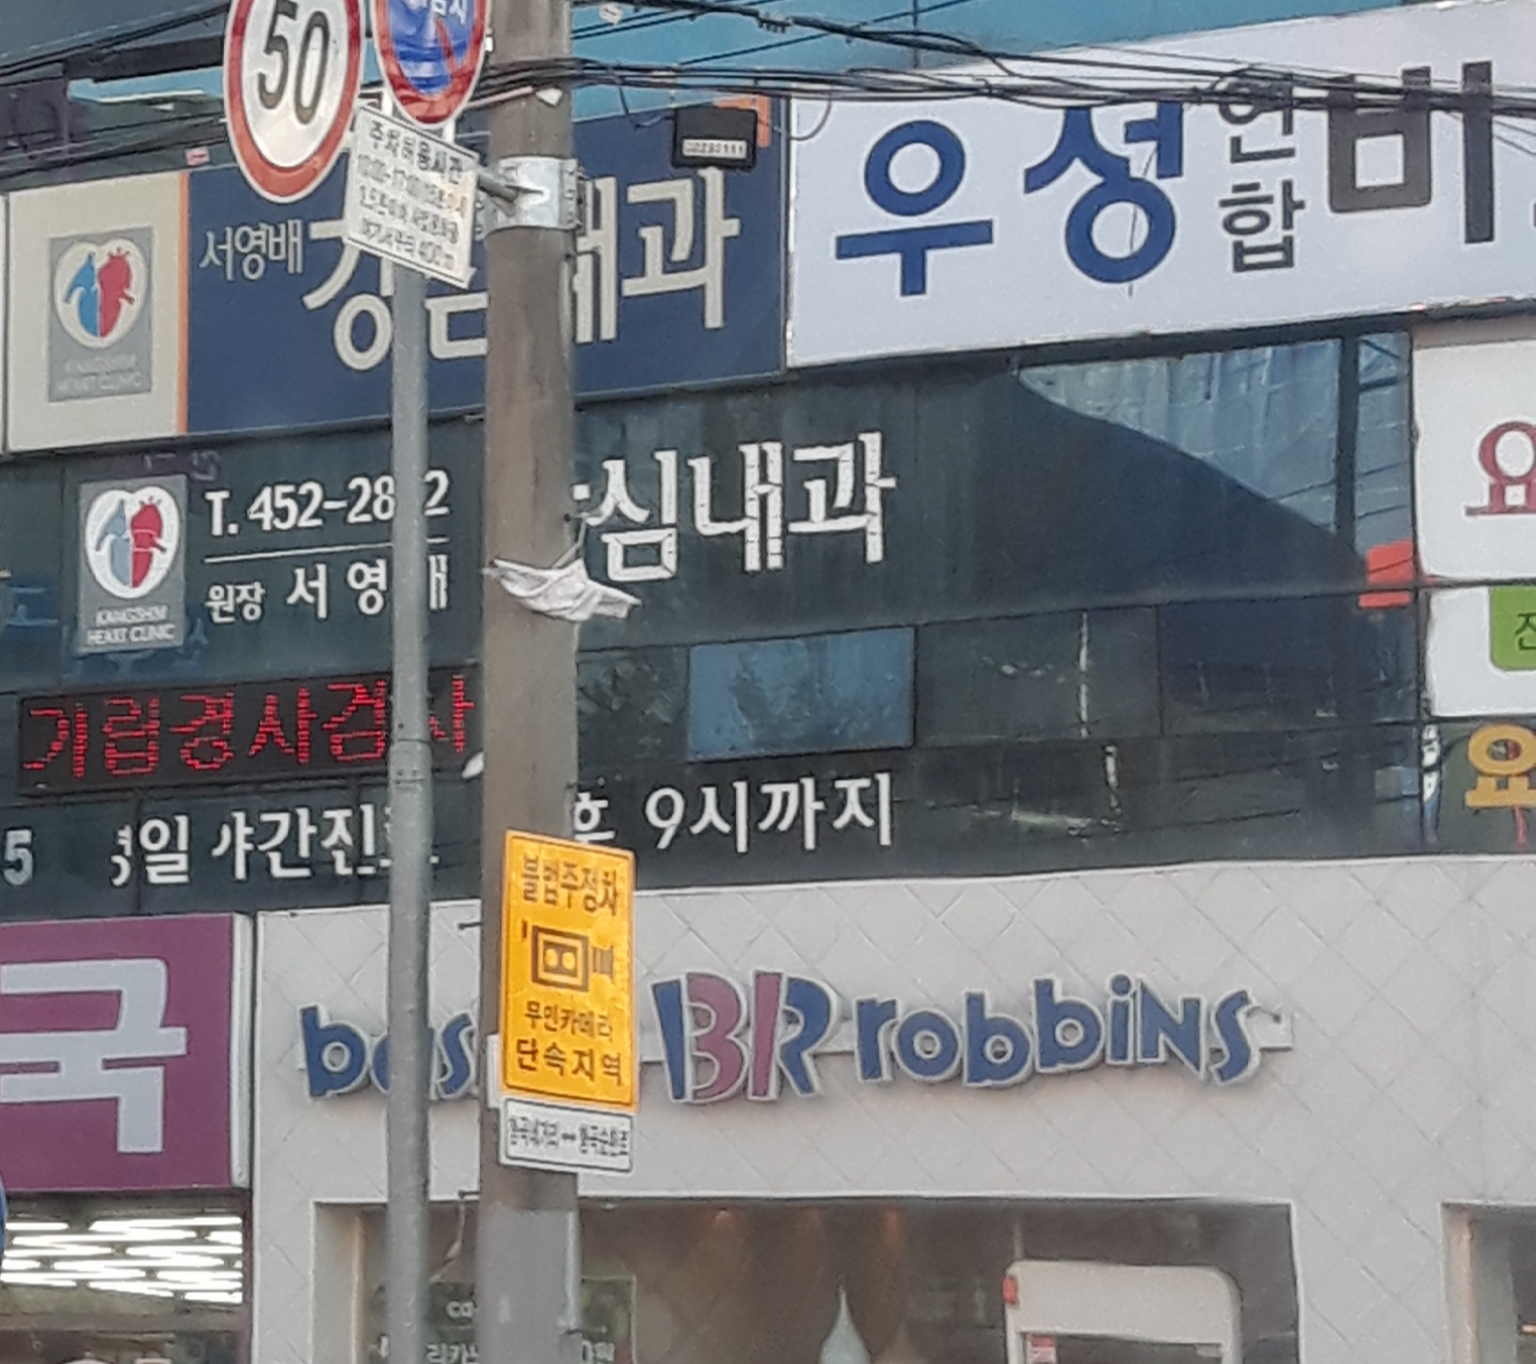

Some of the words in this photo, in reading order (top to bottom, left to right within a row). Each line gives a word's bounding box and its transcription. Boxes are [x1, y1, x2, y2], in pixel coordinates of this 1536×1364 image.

[834, 99, 1186, 298] 우성
[199, 217, 304, 282] 서영배
[205, 468, 451, 537] T.452-282
[205, 581, 267, 625] 원장
[645, 770, 895, 855] 9시까지
[522, 855, 619, 917] 불법주정차
[525, 1000, 614, 1044] 무인카메라
[516, 1036, 622, 1087] 단속지역
